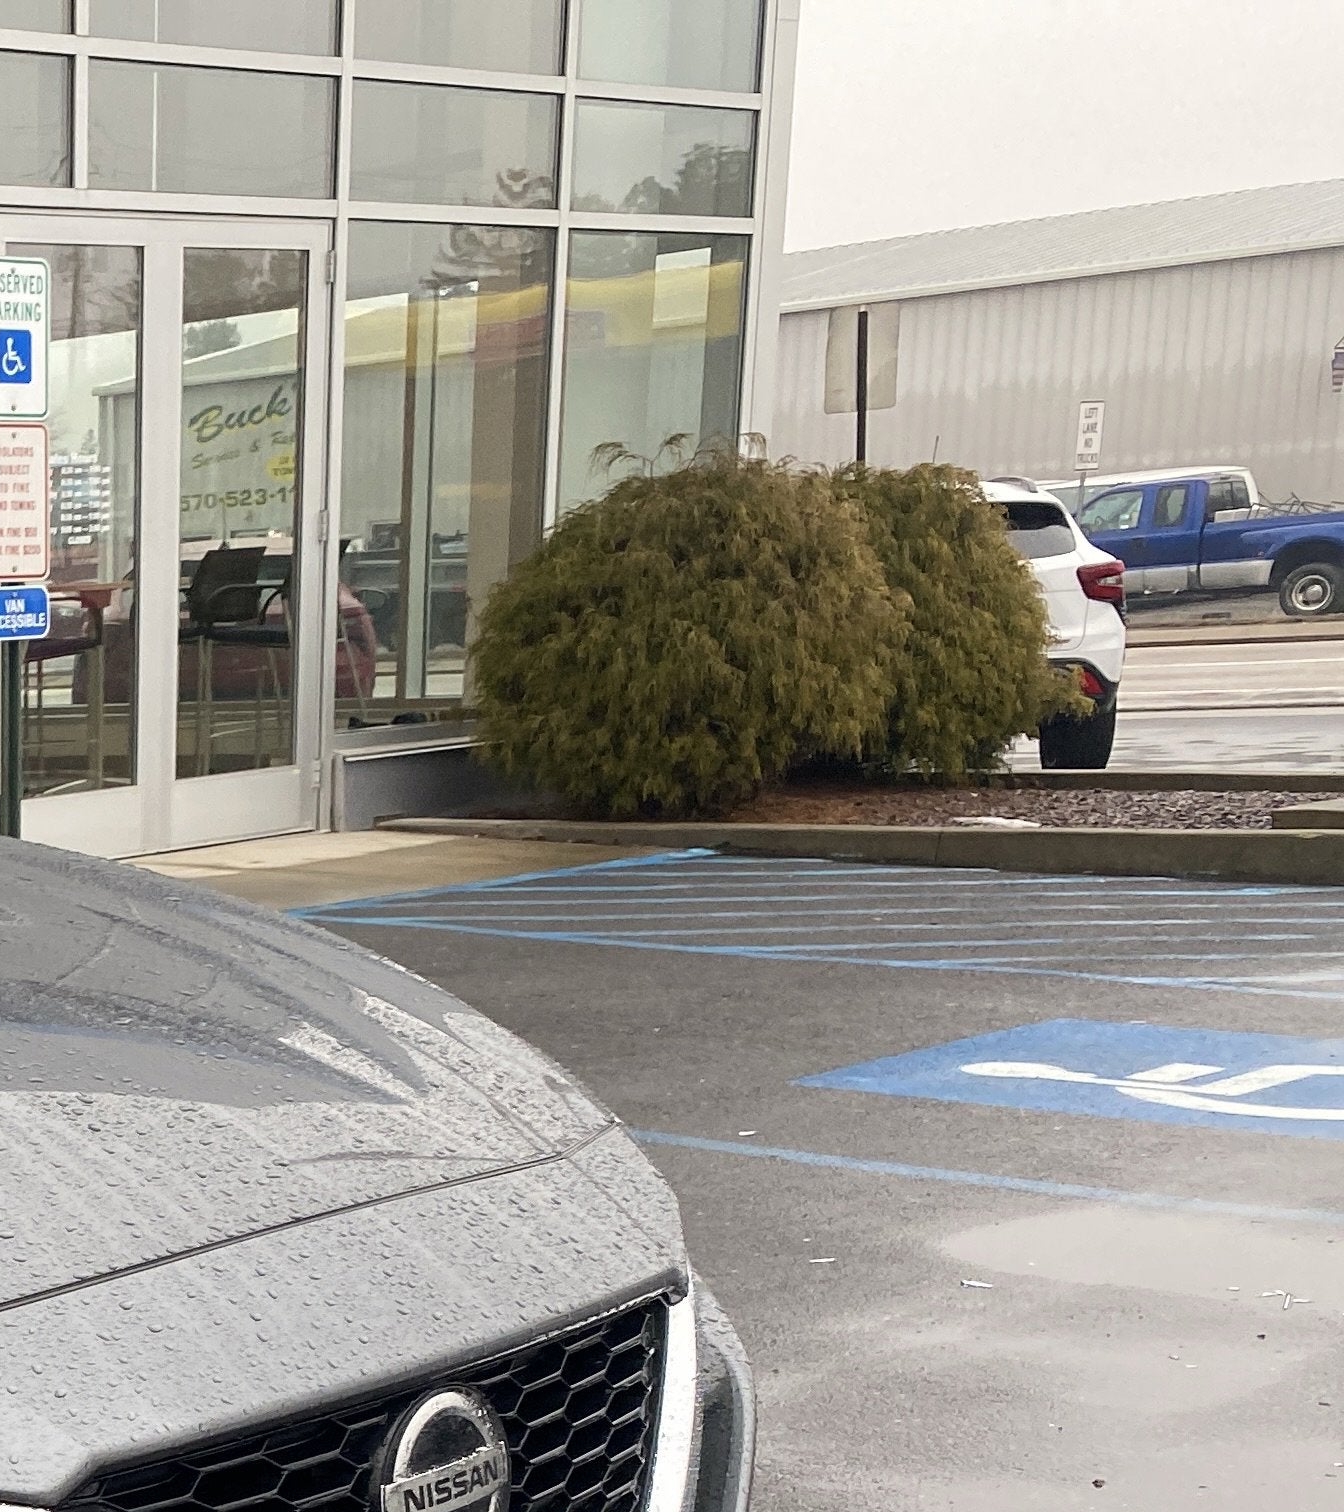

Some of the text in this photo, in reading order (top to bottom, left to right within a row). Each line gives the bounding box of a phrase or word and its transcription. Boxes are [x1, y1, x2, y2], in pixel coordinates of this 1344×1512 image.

[0, 465, 30, 475] SUBJECT
[0, 482, 30, 493] TO FINE
[11, 500, 36, 511] TOWING
[7, 527, 21, 538] FINE
[5, 545, 20, 556] FINE
[4, 598, 26, 614] VAN
